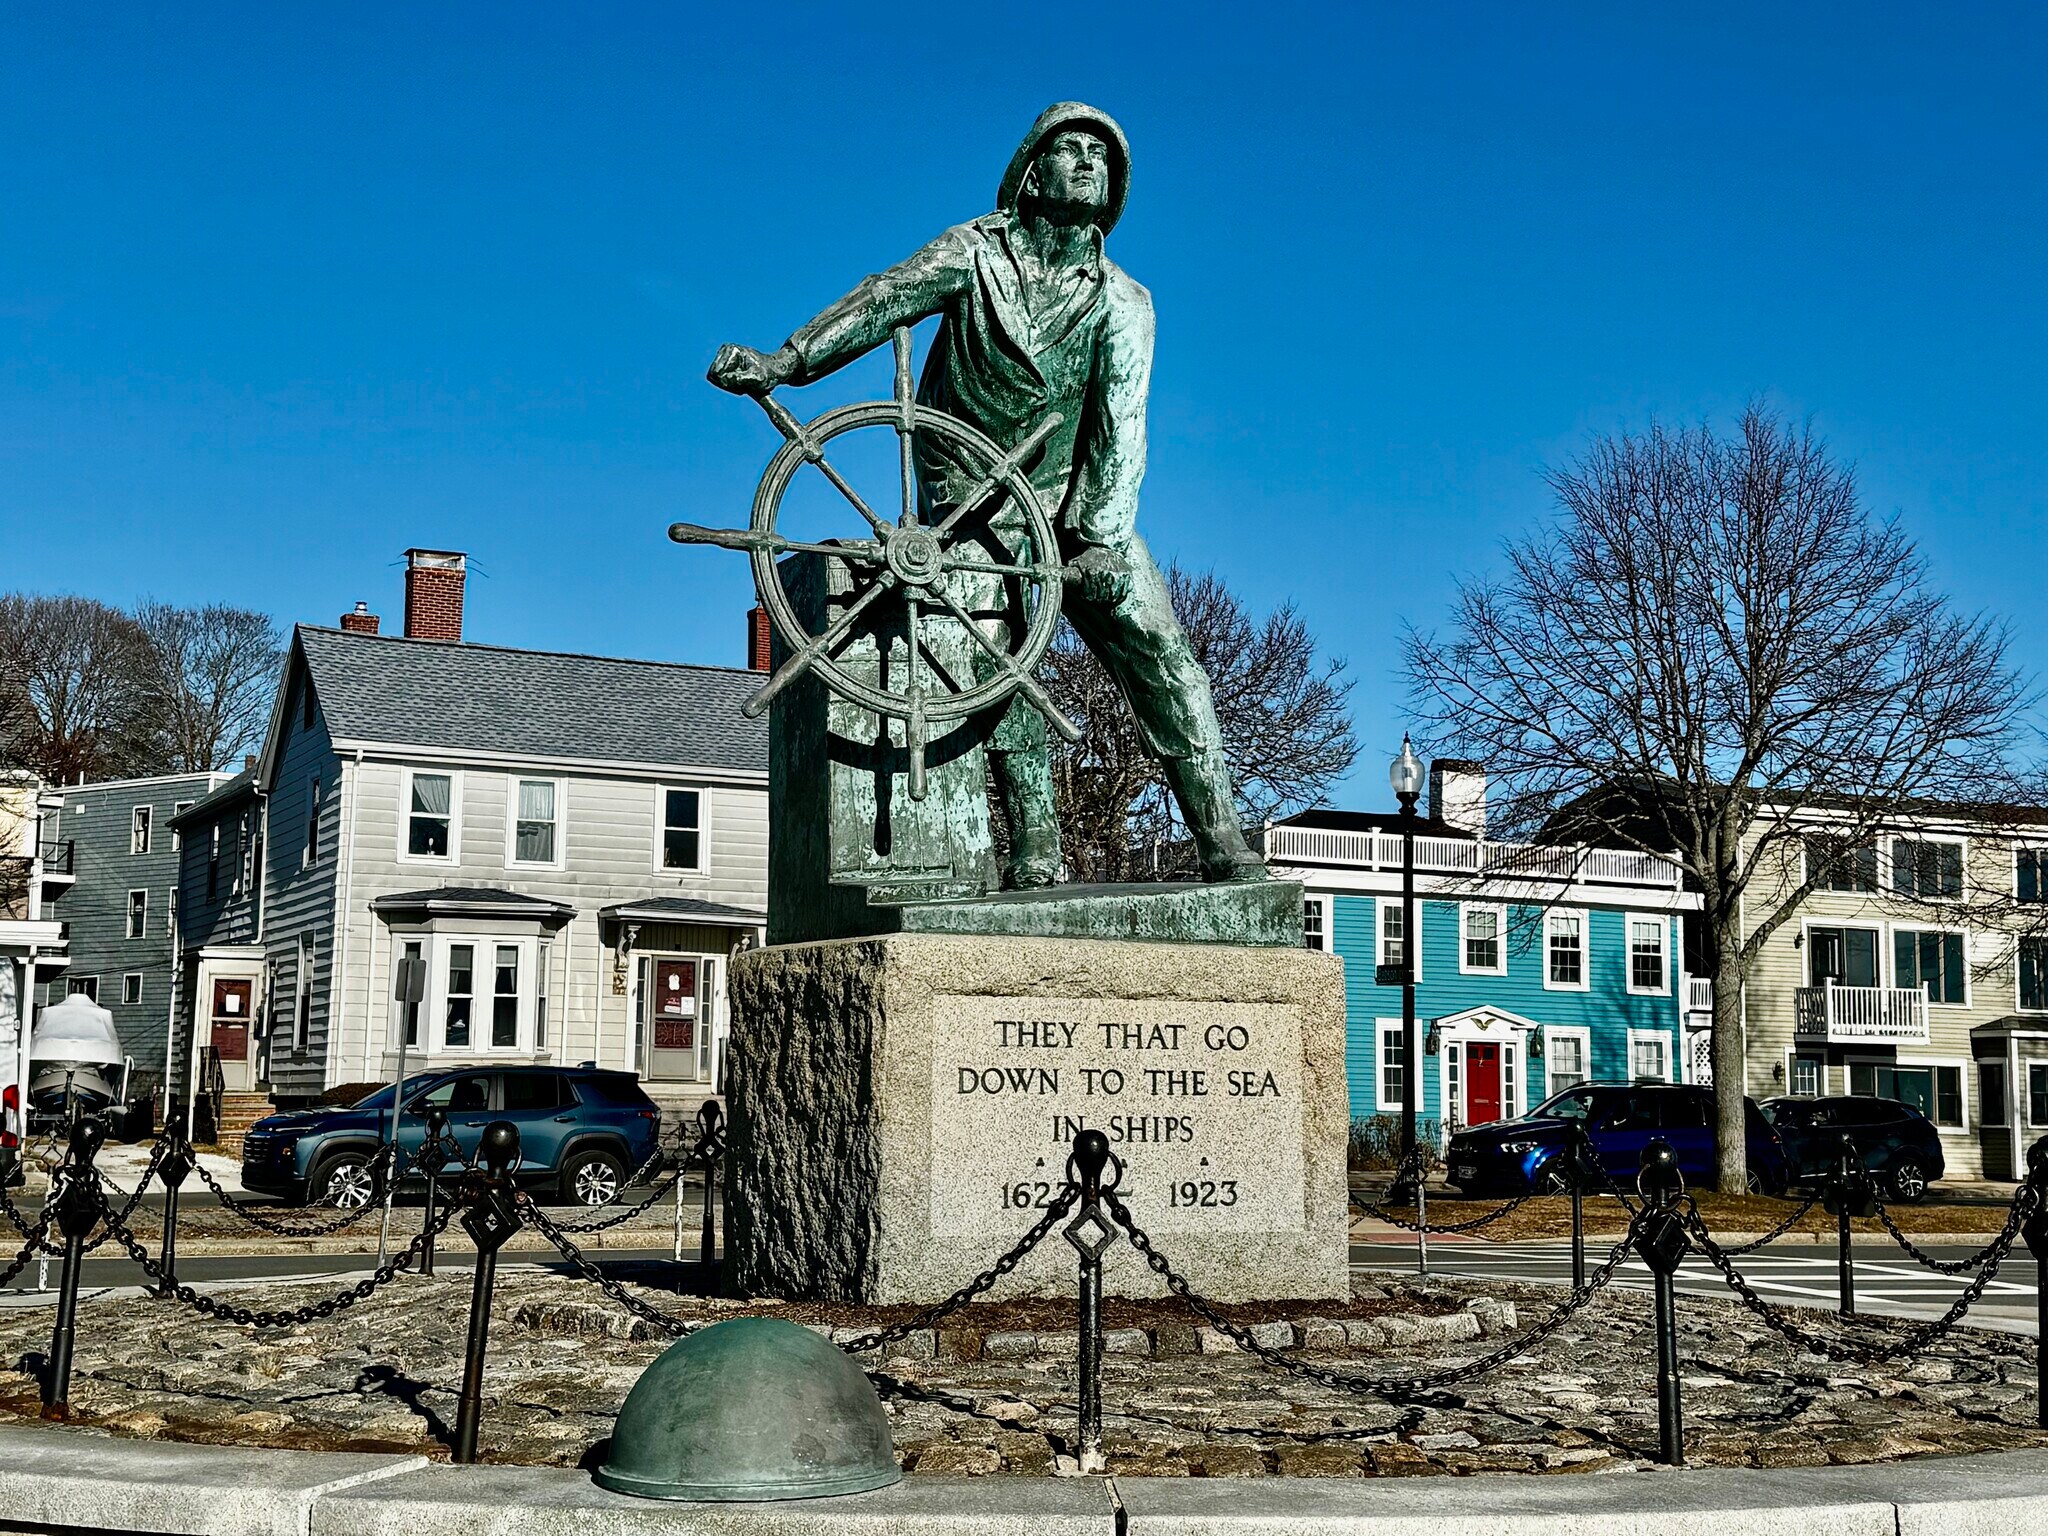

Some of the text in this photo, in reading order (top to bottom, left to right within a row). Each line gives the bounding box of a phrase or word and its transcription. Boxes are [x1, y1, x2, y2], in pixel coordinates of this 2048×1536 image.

[994, 1020, 1250, 1051] THEY THAT GO
[957, 1067, 1281, 1097] DOWN TO THE SEA
[1052, 1115, 1194, 1143] IN SHIPS
[1001, 1181, 1069, 1209] 162
[1169, 1181, 1239, 1208] 1923
